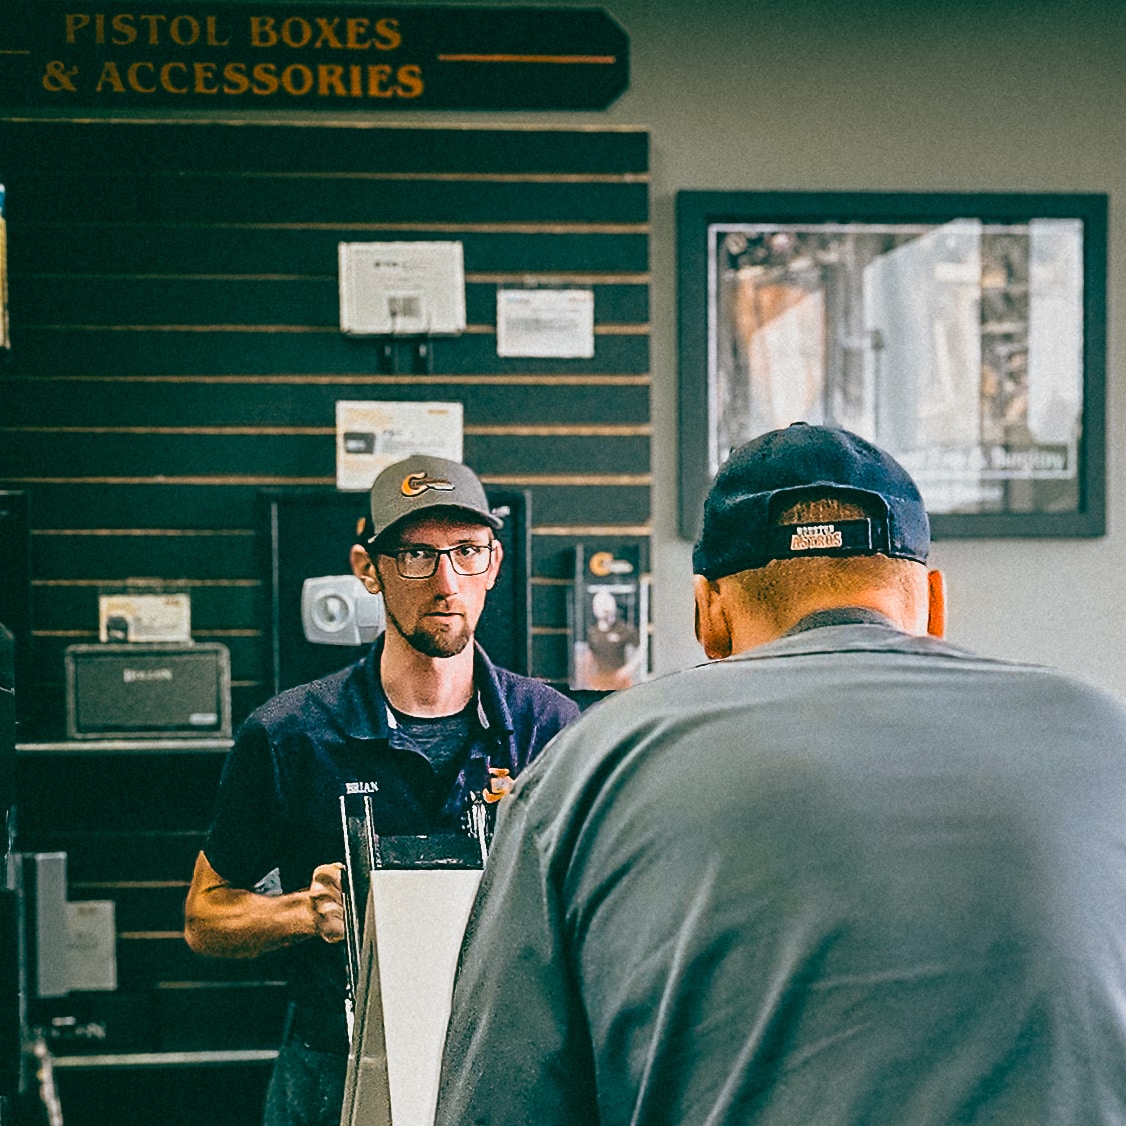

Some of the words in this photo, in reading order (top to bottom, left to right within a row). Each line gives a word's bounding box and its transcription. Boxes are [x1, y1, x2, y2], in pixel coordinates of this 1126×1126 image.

[65, 13, 229, 46] PISTOL
[249, 18, 402, 49] BOXES
[42, 60, 79, 92] &
[96, 62, 425, 98] ACCESSORIES
[791, 532, 843, 550] ASTROS
